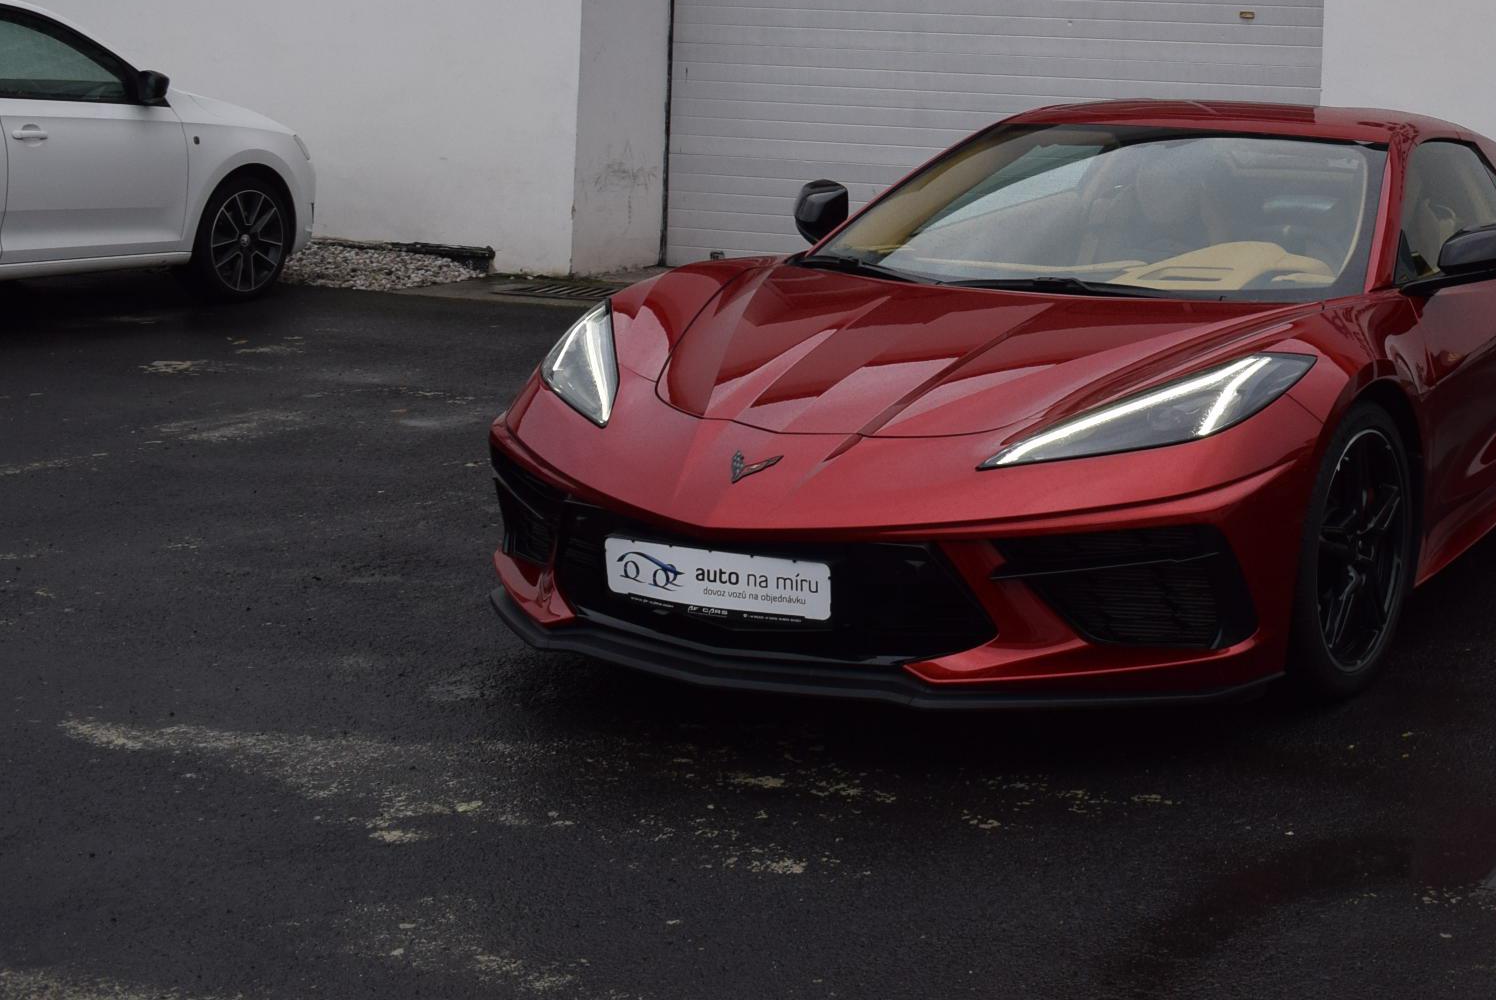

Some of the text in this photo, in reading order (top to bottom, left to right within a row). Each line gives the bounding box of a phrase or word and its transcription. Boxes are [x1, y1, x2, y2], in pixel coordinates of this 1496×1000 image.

[695, 567, 819, 594] auto na míru
[703, 587, 807, 606] dovoz vozů na objednávku
